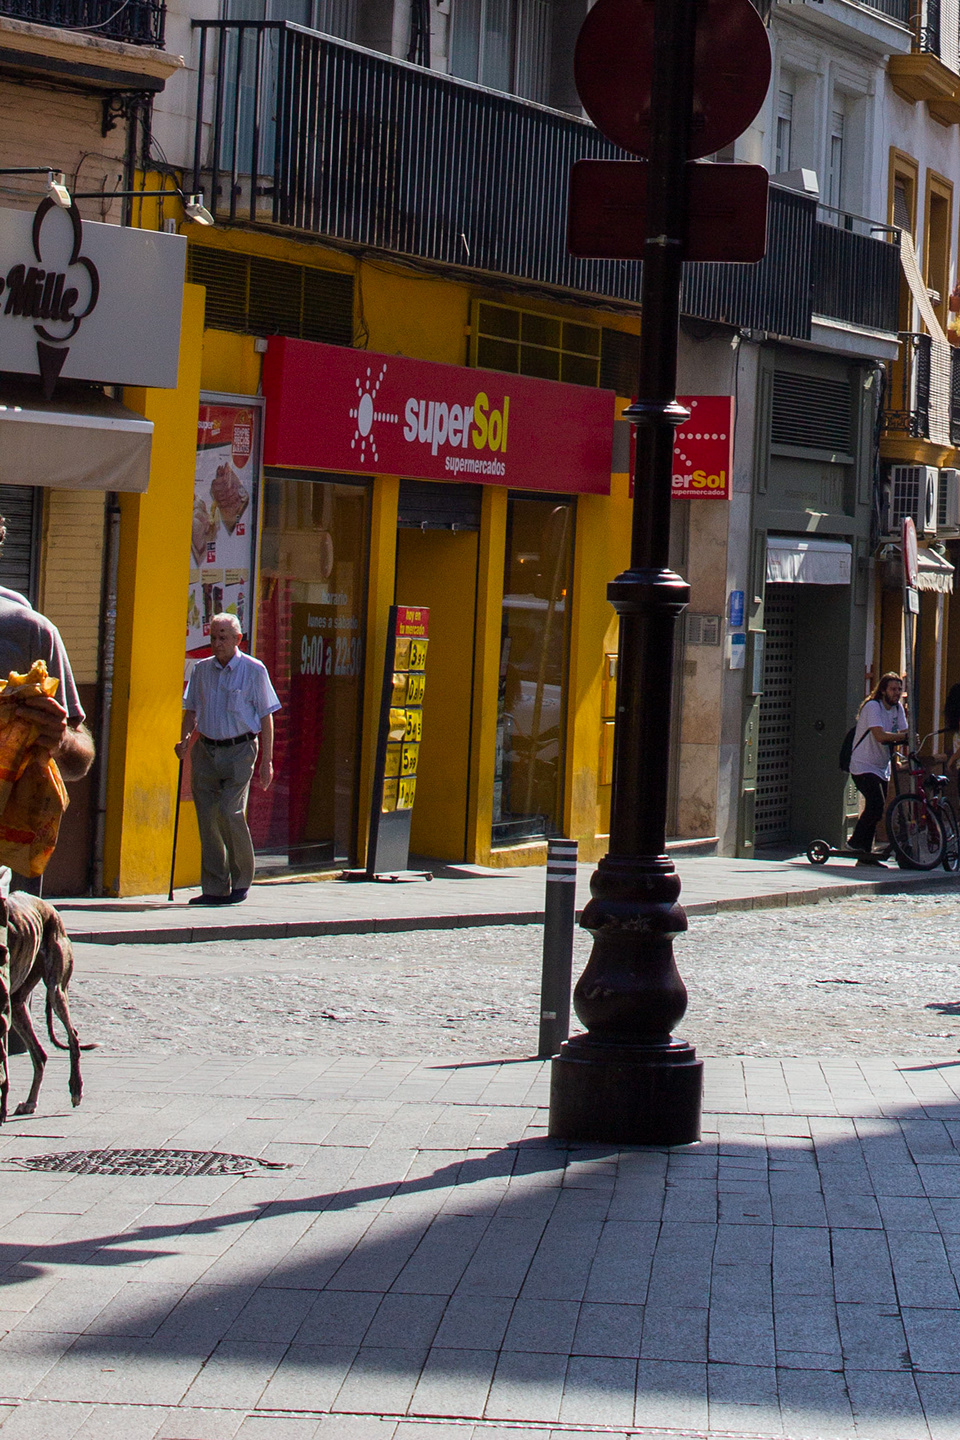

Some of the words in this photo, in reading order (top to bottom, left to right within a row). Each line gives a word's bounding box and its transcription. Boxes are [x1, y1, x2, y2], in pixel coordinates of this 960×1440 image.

[403, 391, 510, 456] superSol
[445, 456, 506, 476] supermercados
[672, 469, 726, 489] erSol
[321, 588, 347, 606] horario
[308, 613, 326, 628] lunes
[328, 617, 333, 628] a
[406, 609, 414, 623] hoy
[415, 611, 421, 621] en
[405, 624, 425, 635] mercado
[301, 634, 323, 675] 9:00
[325, 646, 332, 675] a
